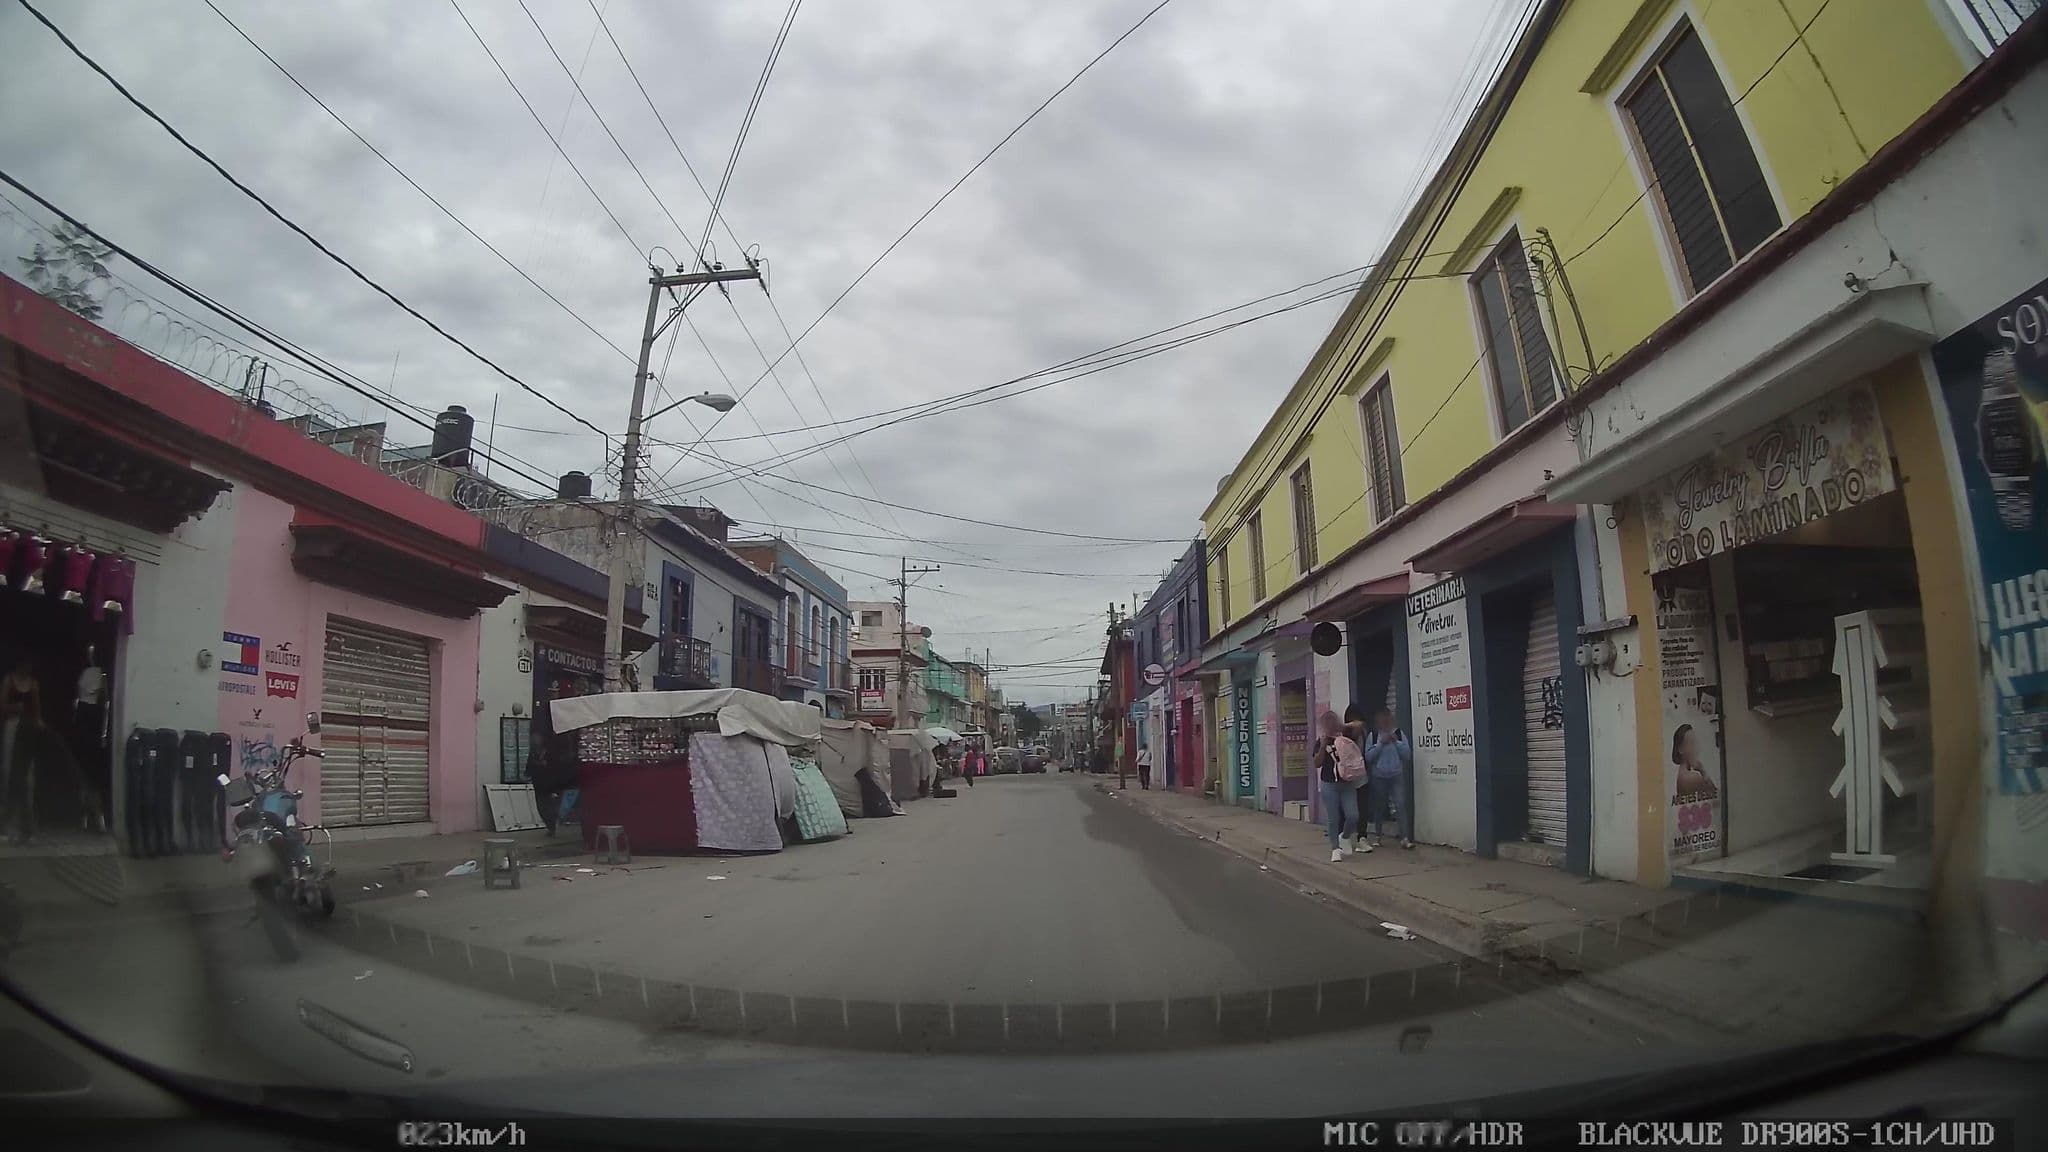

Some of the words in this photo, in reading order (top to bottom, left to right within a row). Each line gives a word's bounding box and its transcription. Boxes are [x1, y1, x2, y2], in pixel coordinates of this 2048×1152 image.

[1676, 465, 1748, 531] Jewelry
[1666, 526, 1715, 567] ORO
[1719, 467, 1866, 551] LAMINADO
[1408, 576, 1466, 615] VETERINARIA
[265, 649, 301, 668] HOLLISTER
[547, 648, 597, 672] CONTACTOS
[1662, 667, 1695, 678] PRODUCTO
[1663, 677, 1706, 689] GARANTIZADO
[1238, 687, 1251, 787] NOVEDADES
[1418, 735, 1441, 748] LABYES
[1674, 830, 1716, 848] MAYOREO
